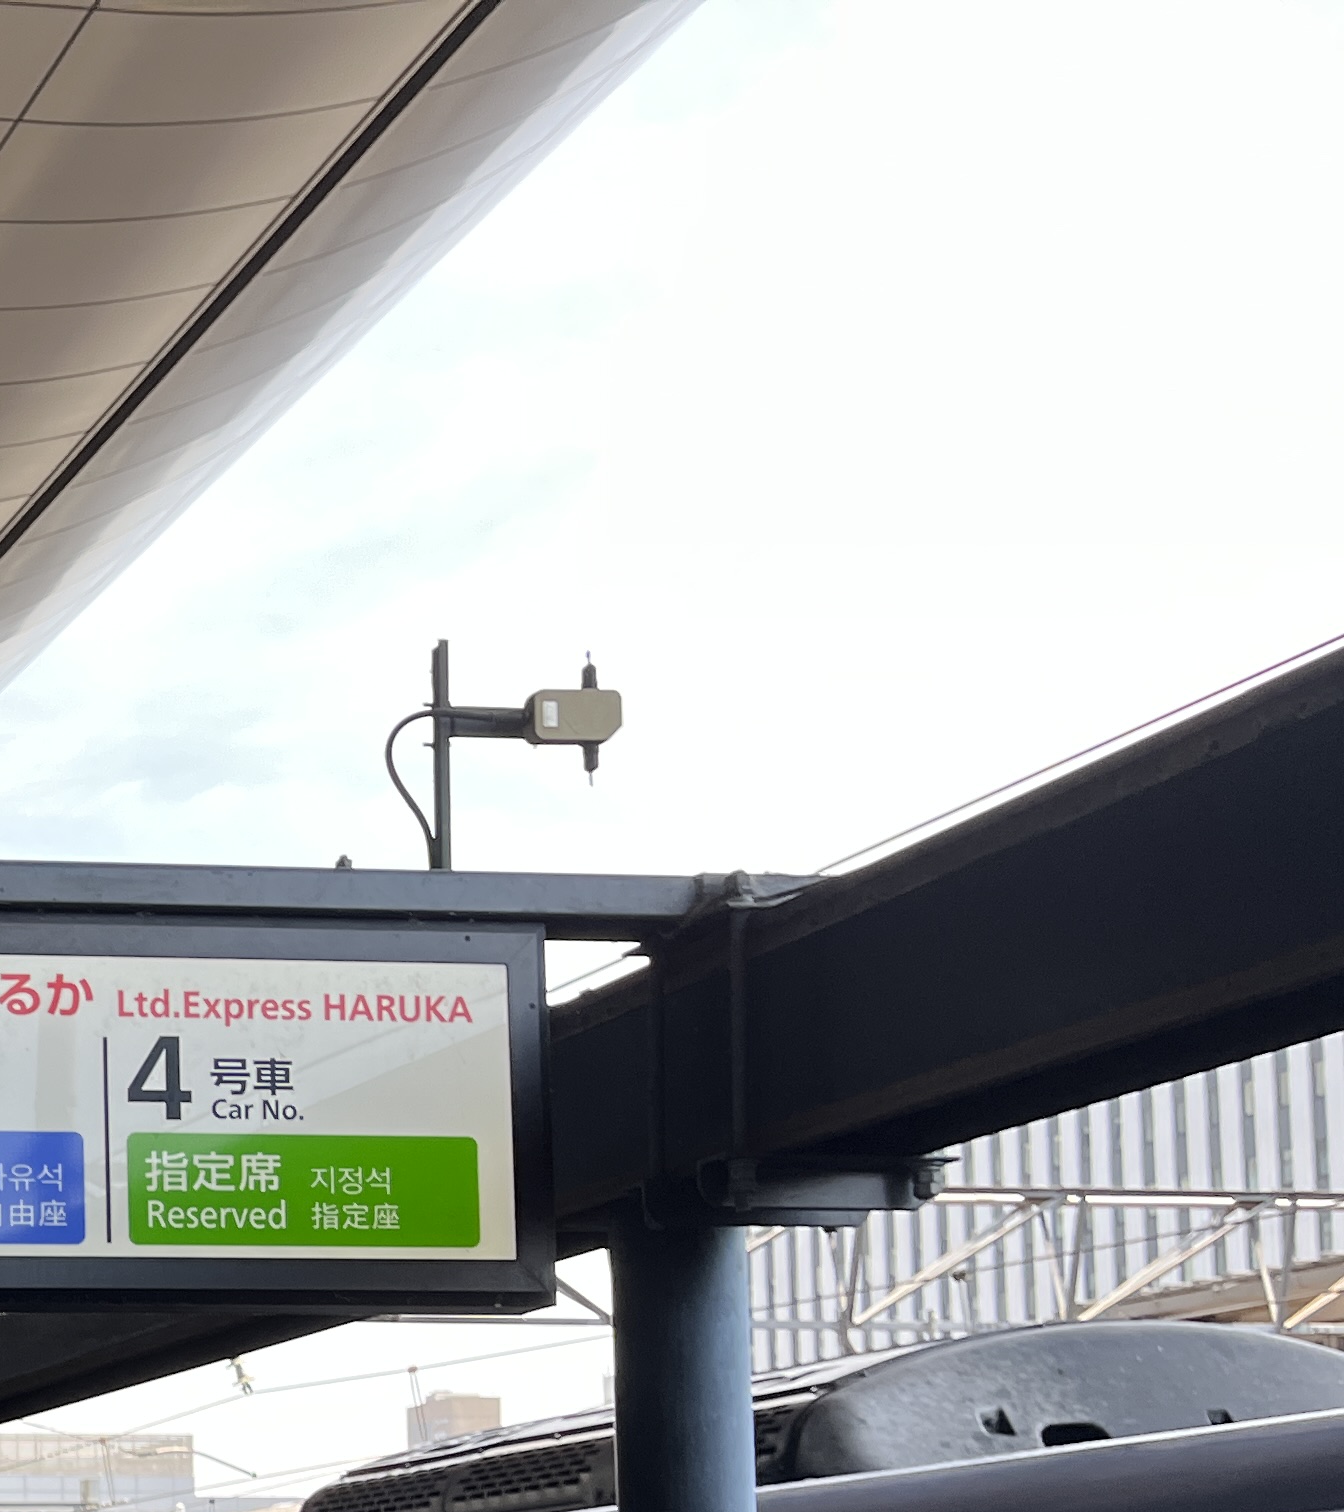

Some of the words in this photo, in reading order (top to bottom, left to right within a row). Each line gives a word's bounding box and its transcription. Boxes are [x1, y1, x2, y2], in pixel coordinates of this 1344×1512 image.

[117, 988, 313, 1027] Ltd.Express
[323, 993, 474, 1024] HARUKA
[127, 1035, 193, 1121] 4
[210, 1057, 294, 1096] 号車
[211, 1099, 254, 1121] Car
[262, 1099, 305, 1121] No.
[144, 1150, 282, 1193] 指定席
[310, 1166, 392, 1195] 지정석
[147, 1199, 287, 1231] Reserved
[311, 1202, 401, 1231] 指定座
